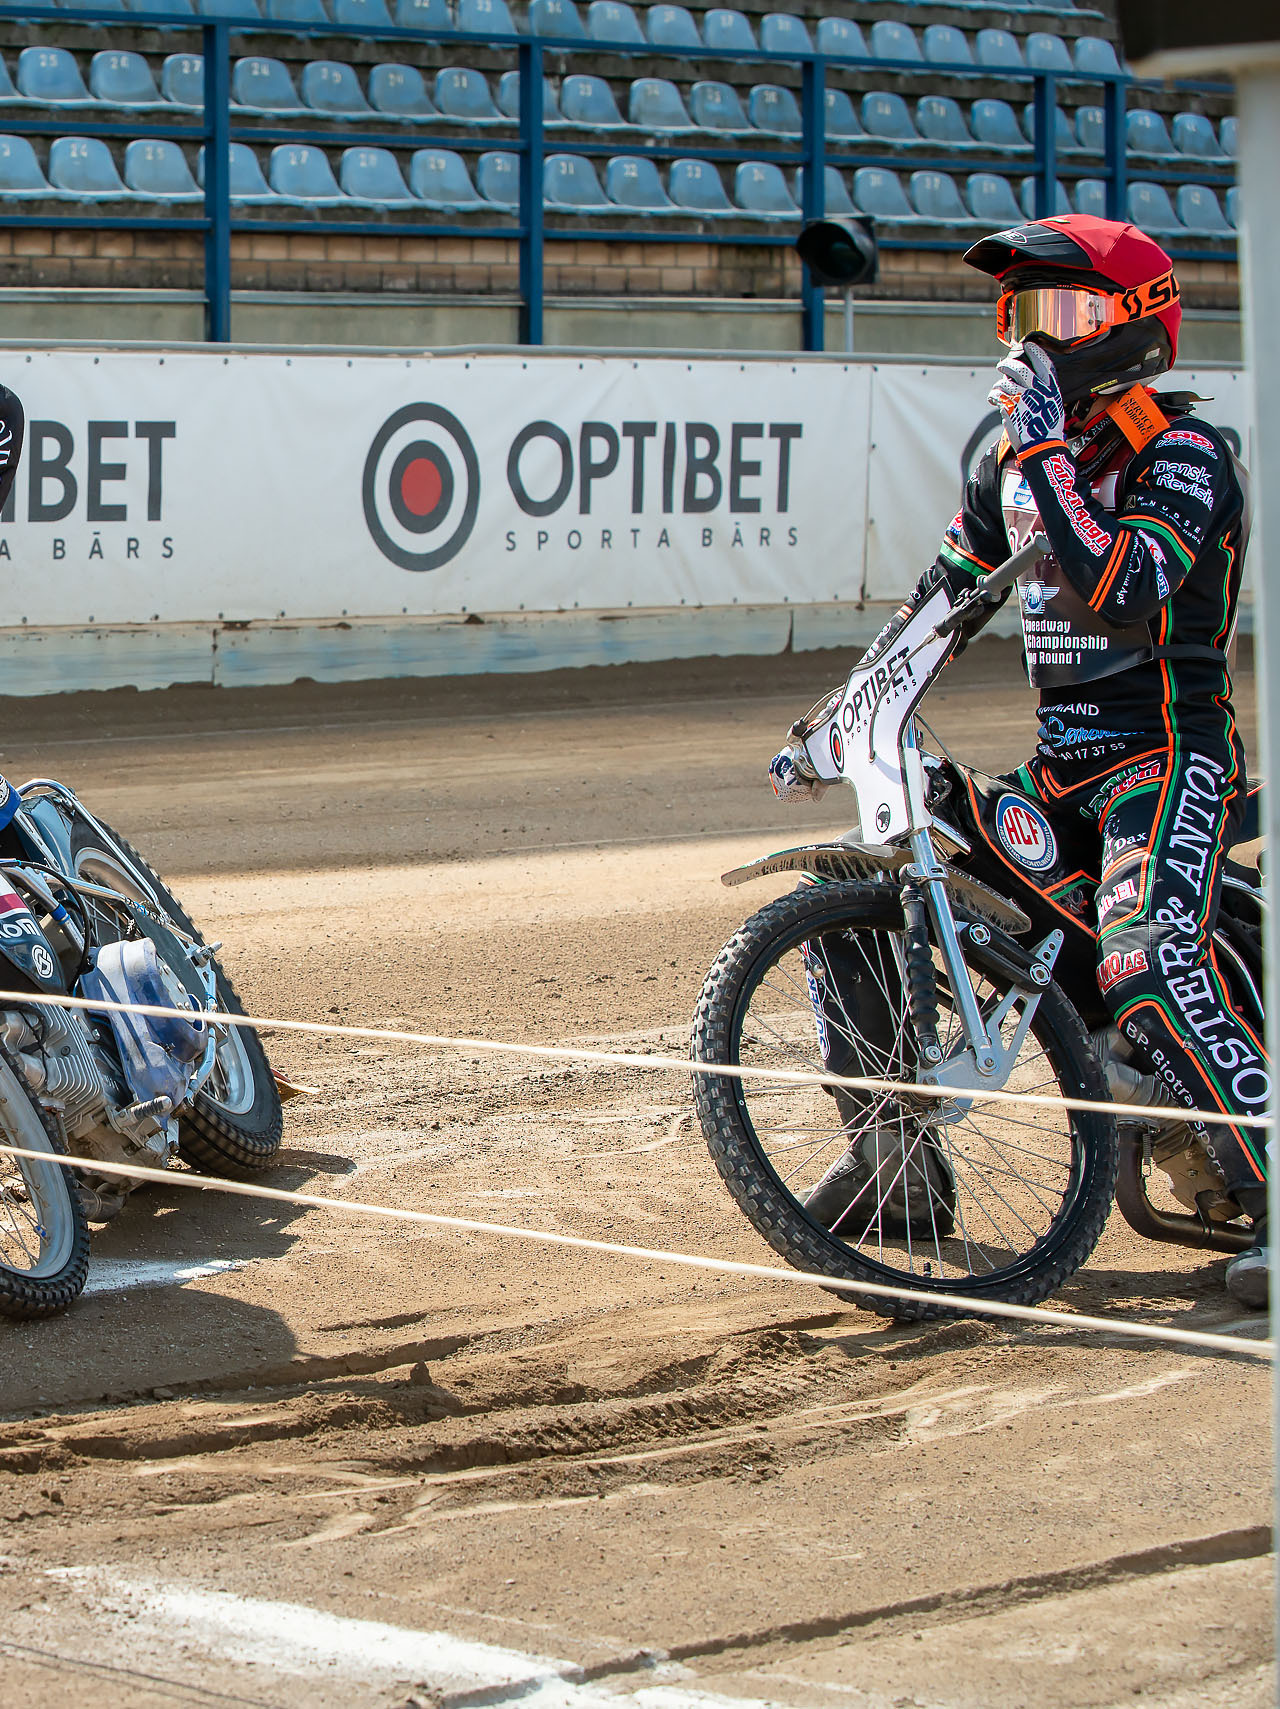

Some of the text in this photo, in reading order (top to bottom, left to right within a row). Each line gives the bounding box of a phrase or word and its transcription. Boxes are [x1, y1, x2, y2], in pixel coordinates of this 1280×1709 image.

[507, 420, 803, 517] OPTIBET
[1049, 455, 1084, 508] Torben
[1153, 460, 1213, 486] Dansk
[53, 532, 174, 560] BĀRS
[506, 522, 798, 551] SPORTA BĀRS
[1026, 635, 1108, 651] Championship
[1039, 652, 1072, 665] Round
[1075, 652, 1081, 665] 1
[886, 679, 917, 704] BĀRS
[1075, 748, 1088, 760] 17
[1092, 745, 1105, 756] 37
[1110, 742, 1126, 751] 55
[1004, 807, 1039, 845] HCF
[1114, 832, 1147, 852] Dax
[1156, 897, 1198, 935] &
[1126, 1021, 1149, 1051] BP.
